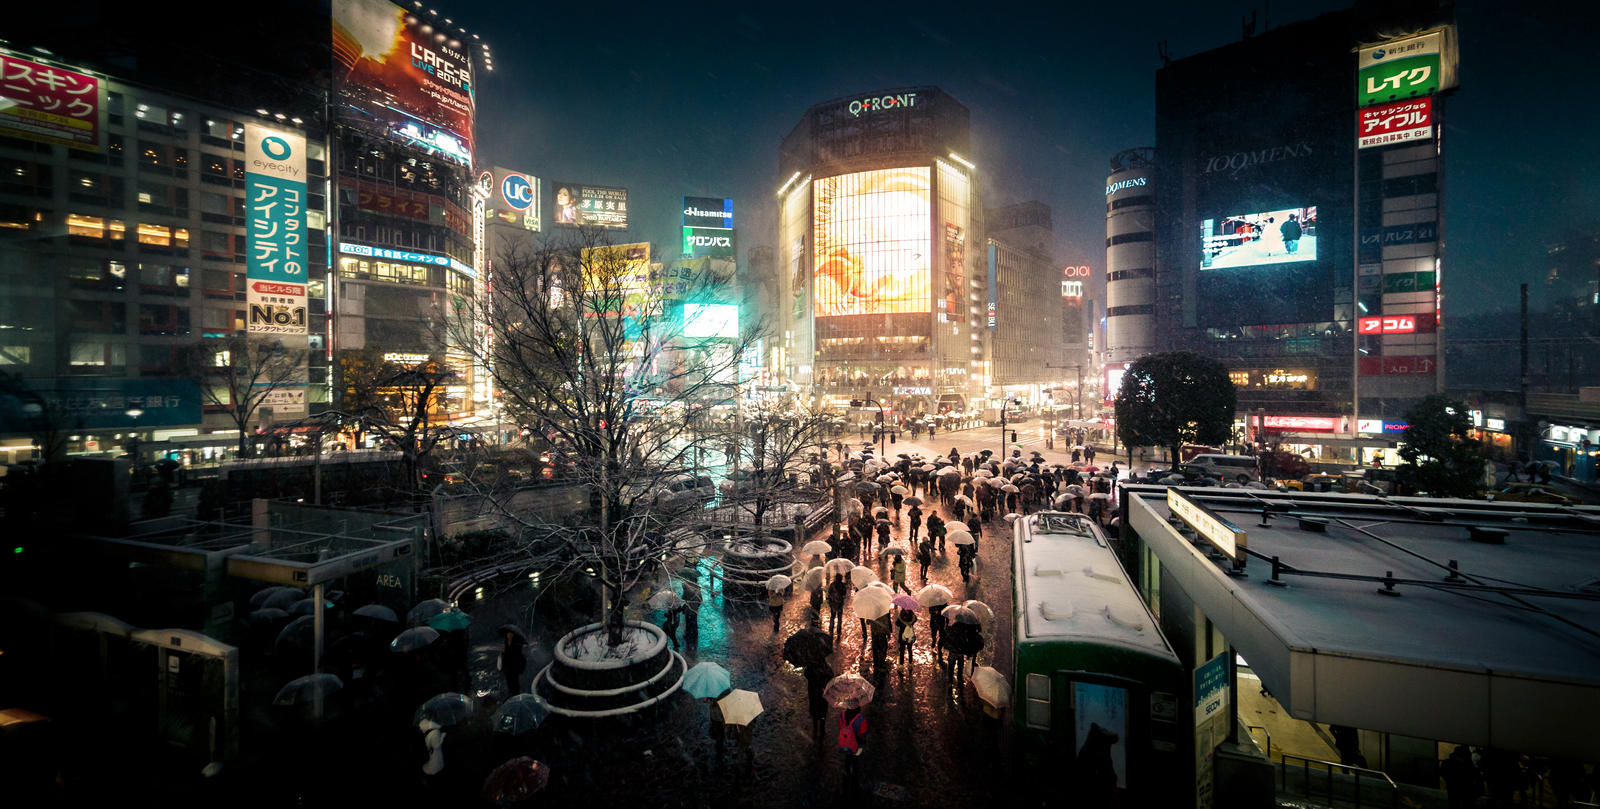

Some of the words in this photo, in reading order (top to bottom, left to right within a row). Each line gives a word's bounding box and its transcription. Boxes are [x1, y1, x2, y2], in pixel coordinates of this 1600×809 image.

[1388, 42, 1425, 55] 新生銀行
[0, 57, 94, 95] スキン
[411, 57, 435, 75] LIVE
[436, 69, 463, 87] 2014
[1367, 66, 1431, 94] レイク
[849, 92, 917, 117] QFRONT
[1363, 103, 1427, 119] キャッシングなら
[1363, 111, 1428, 133] アイフル
[1362, 133, 1411, 146] 新規会員募集中
[253, 159, 299, 176] eyecity
[505, 181, 532, 203] UC
[683, 206, 733, 219] Hisamitsu
[253, 183, 279, 273] アイシティ
[284, 188, 301, 275] コンタクトの
[686, 235, 731, 248] サロンパス
[259, 284, 302, 295] 当ビル5階
[249, 303, 306, 327] No.1
[249, 324, 306, 334] コンタクトショップ
[1364, 318, 1414, 331] アコム
[376, 573, 403, 590] AREA
